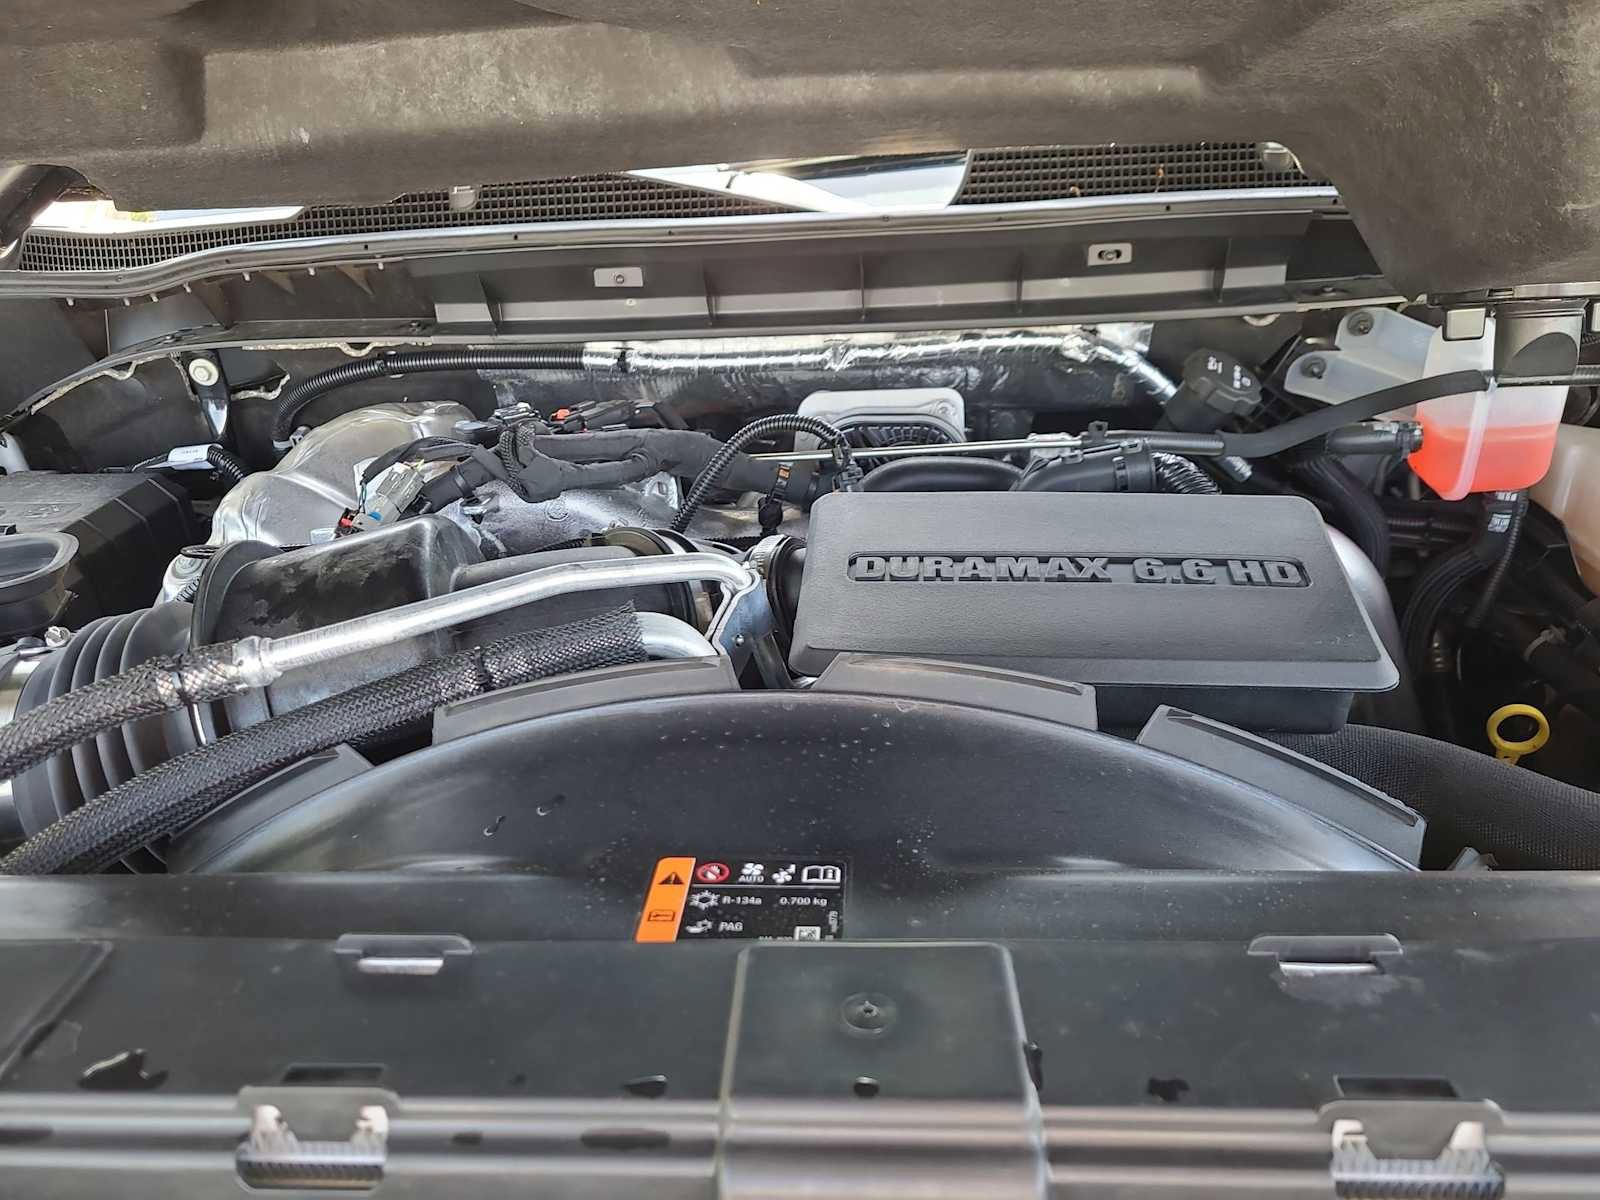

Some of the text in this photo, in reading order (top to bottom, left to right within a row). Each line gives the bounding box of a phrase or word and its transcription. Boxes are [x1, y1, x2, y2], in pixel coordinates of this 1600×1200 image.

[853, 556, 1306, 588] DURAMAX 6.6 HD
[738, 875, 765, 883] AUTO
[721, 896, 828, 907] R-134a 0.700 kg
[718, 922, 744, 932] PAG
